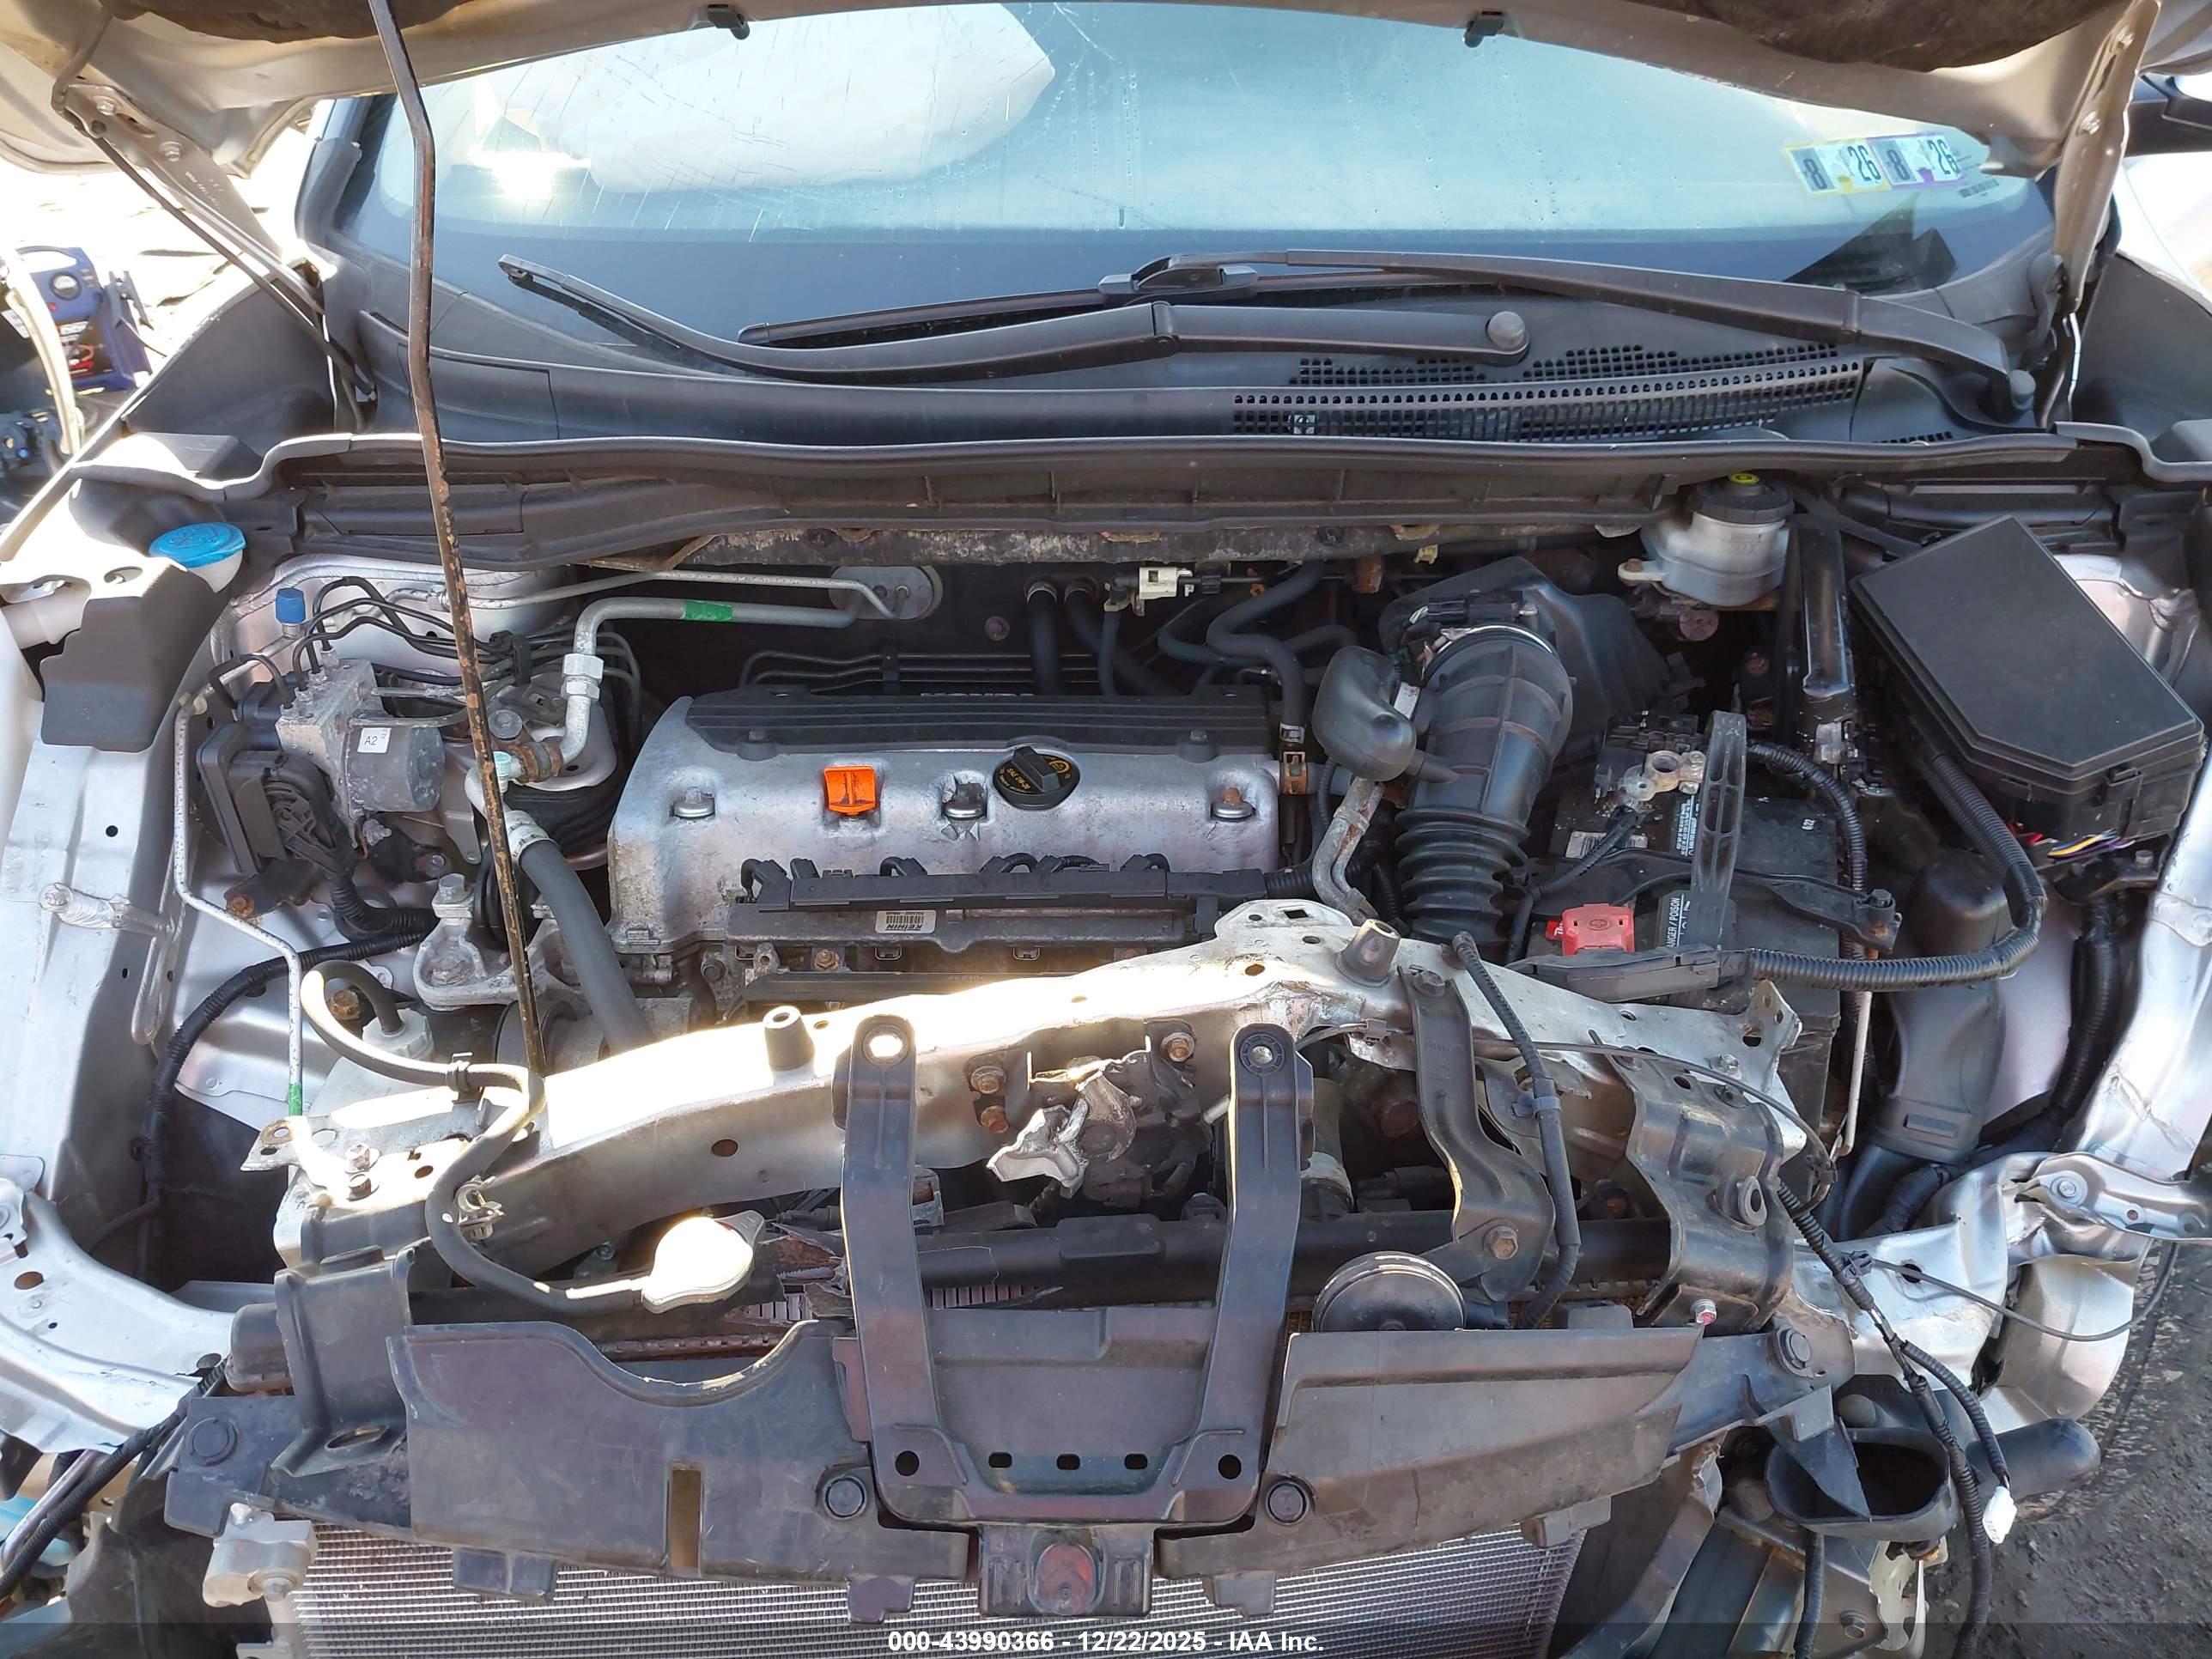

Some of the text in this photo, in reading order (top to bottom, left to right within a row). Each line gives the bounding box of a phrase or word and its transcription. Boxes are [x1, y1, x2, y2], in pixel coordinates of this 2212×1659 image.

[1803, 144, 1881, 189] 8 26
[1885, 149, 1911, 180] 8
[1927, 139, 1961, 174] 26
[364, 735, 378, 745] A2
[1668, 897, 1680, 921] POISON
[1667, 927, 1678, 948] ANGER
